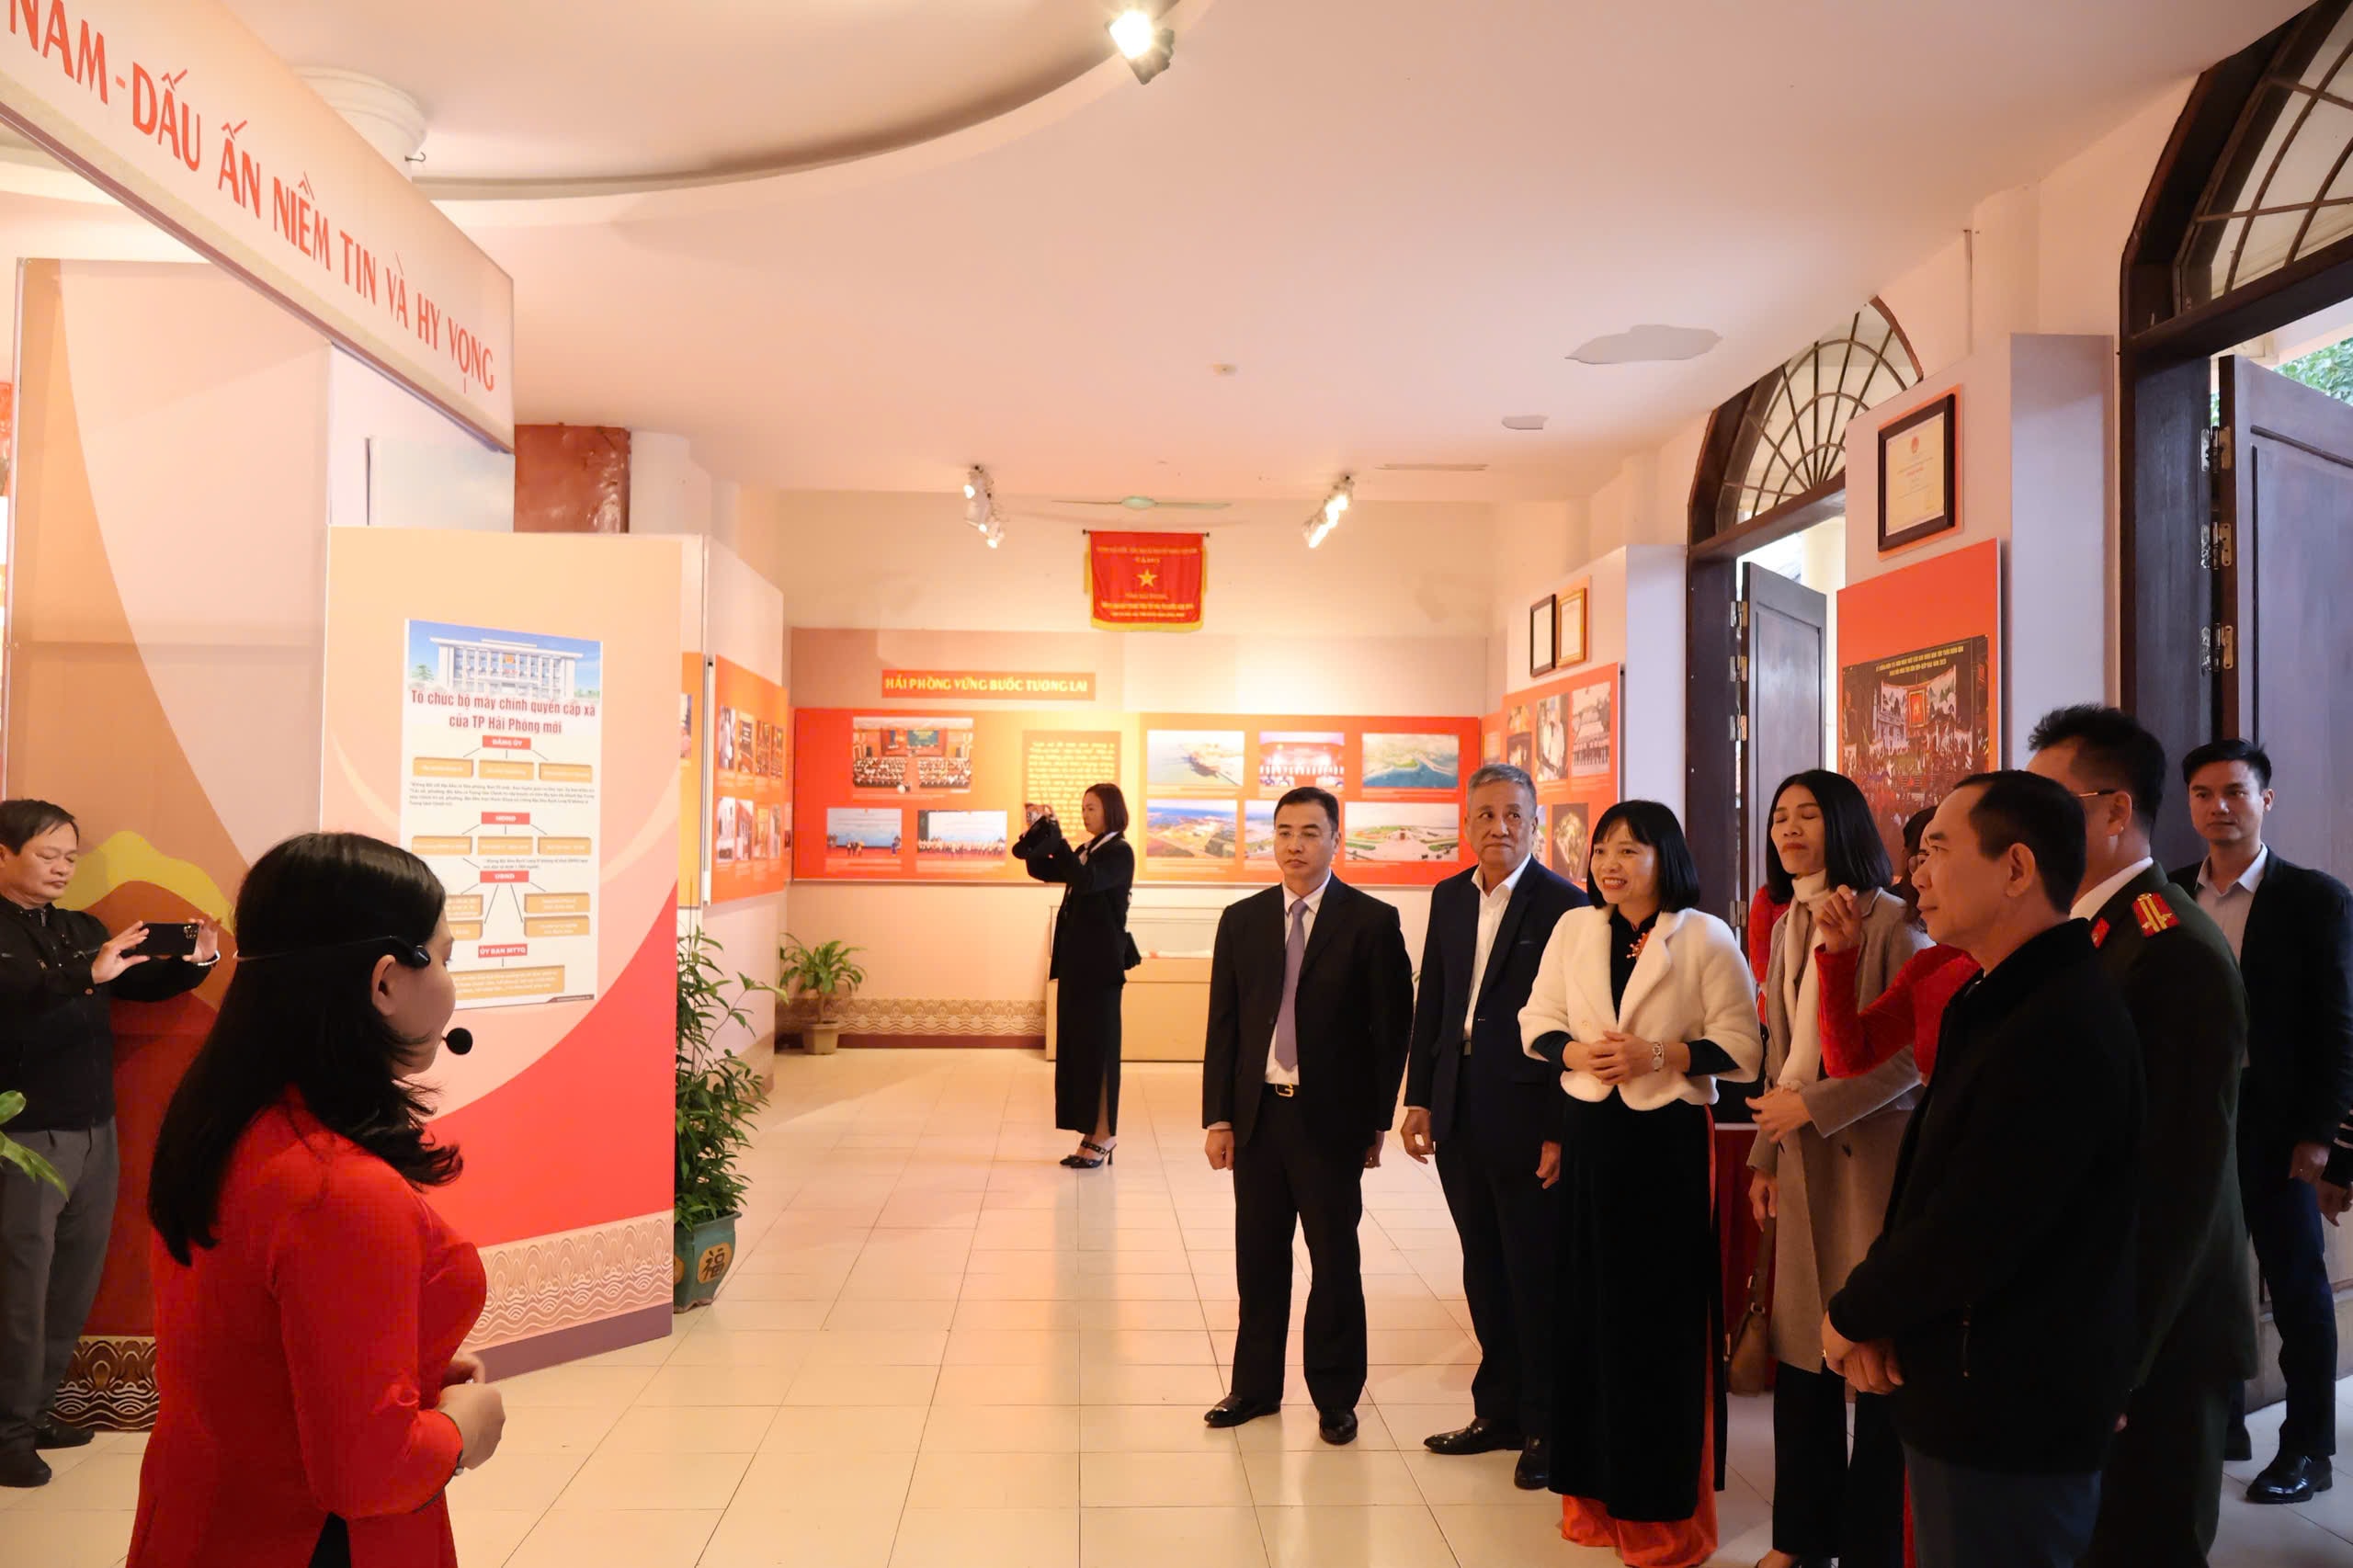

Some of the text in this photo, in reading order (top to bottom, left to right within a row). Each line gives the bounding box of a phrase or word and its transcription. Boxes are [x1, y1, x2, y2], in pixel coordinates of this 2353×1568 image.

[217, 119, 261, 220] ẤN
[273, 170, 332, 272] NIỀM
[339, 229, 377, 306] TIN
[385, 251, 409, 331] VÀ
[416, 291, 440, 350] HY
[447, 315, 495, 394] VỌNG
[909, 676, 951, 690] PHÒNG
[1069, 679, 1088, 692] LAI
[457, 694, 471, 710] bộ
[472, 715, 485, 729] TP
[701, 1246, 726, 1281] 福
